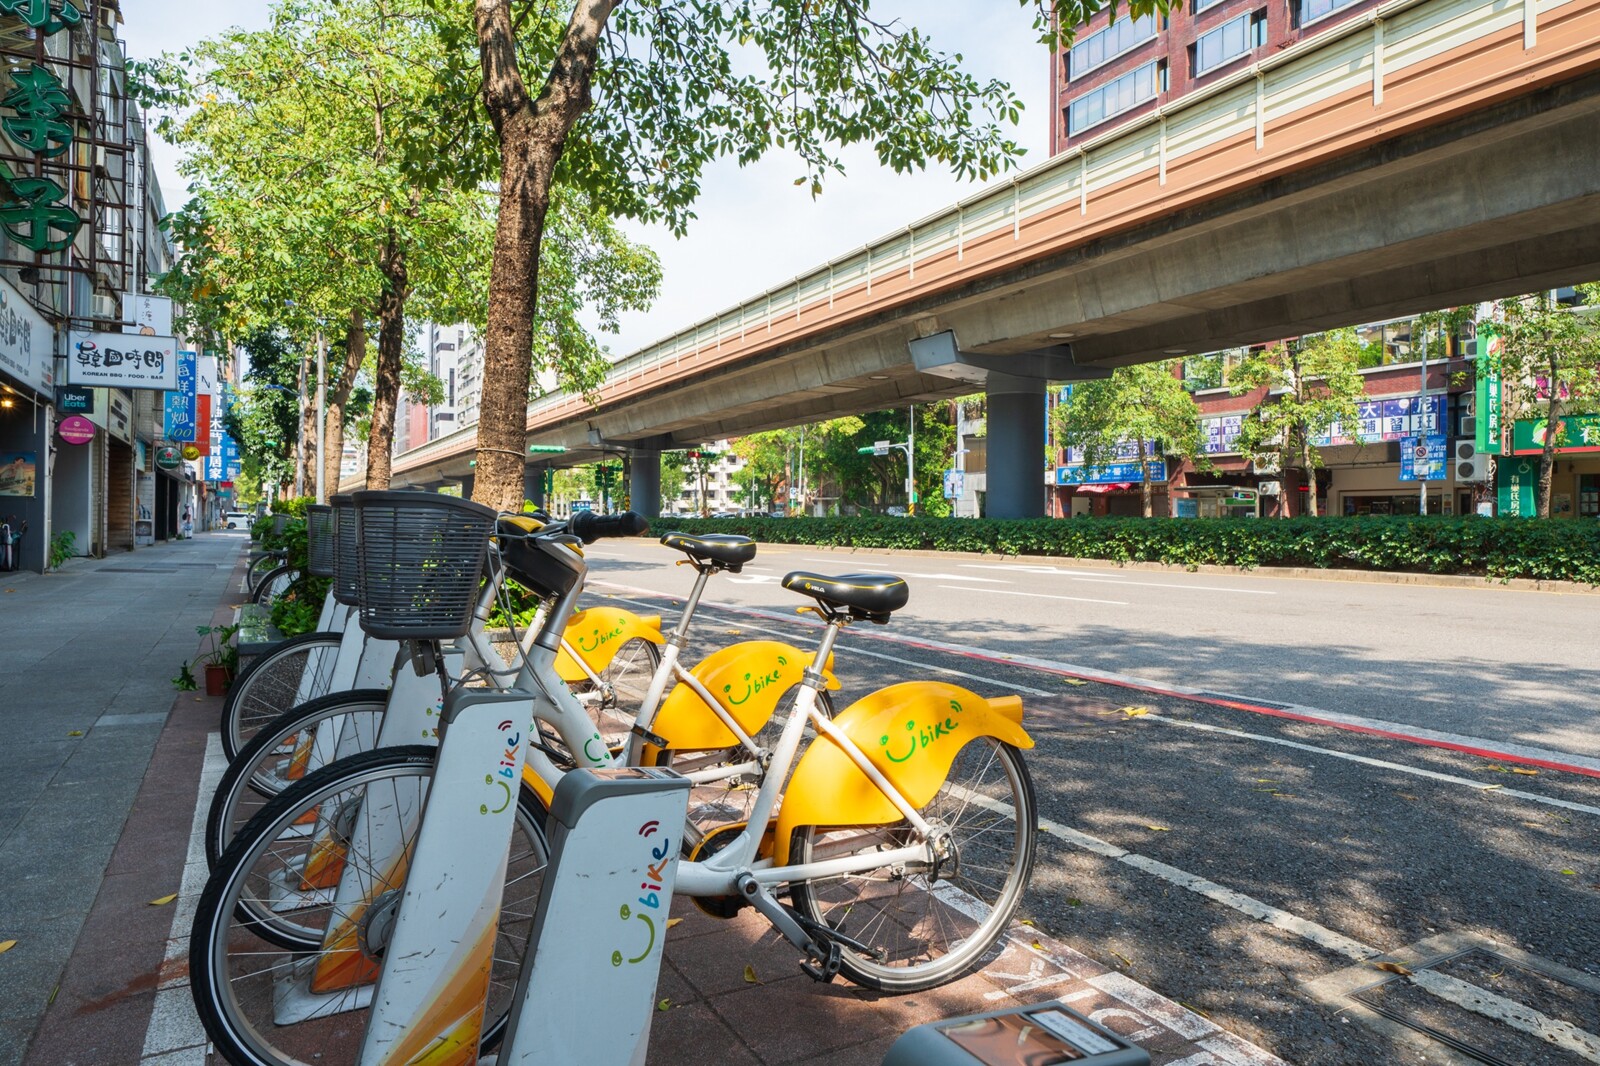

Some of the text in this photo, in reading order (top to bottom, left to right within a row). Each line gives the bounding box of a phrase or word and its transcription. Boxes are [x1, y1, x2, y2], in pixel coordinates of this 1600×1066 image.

[76, 341, 164, 374] 韓國時間
[64, 393, 86, 401] Uber
